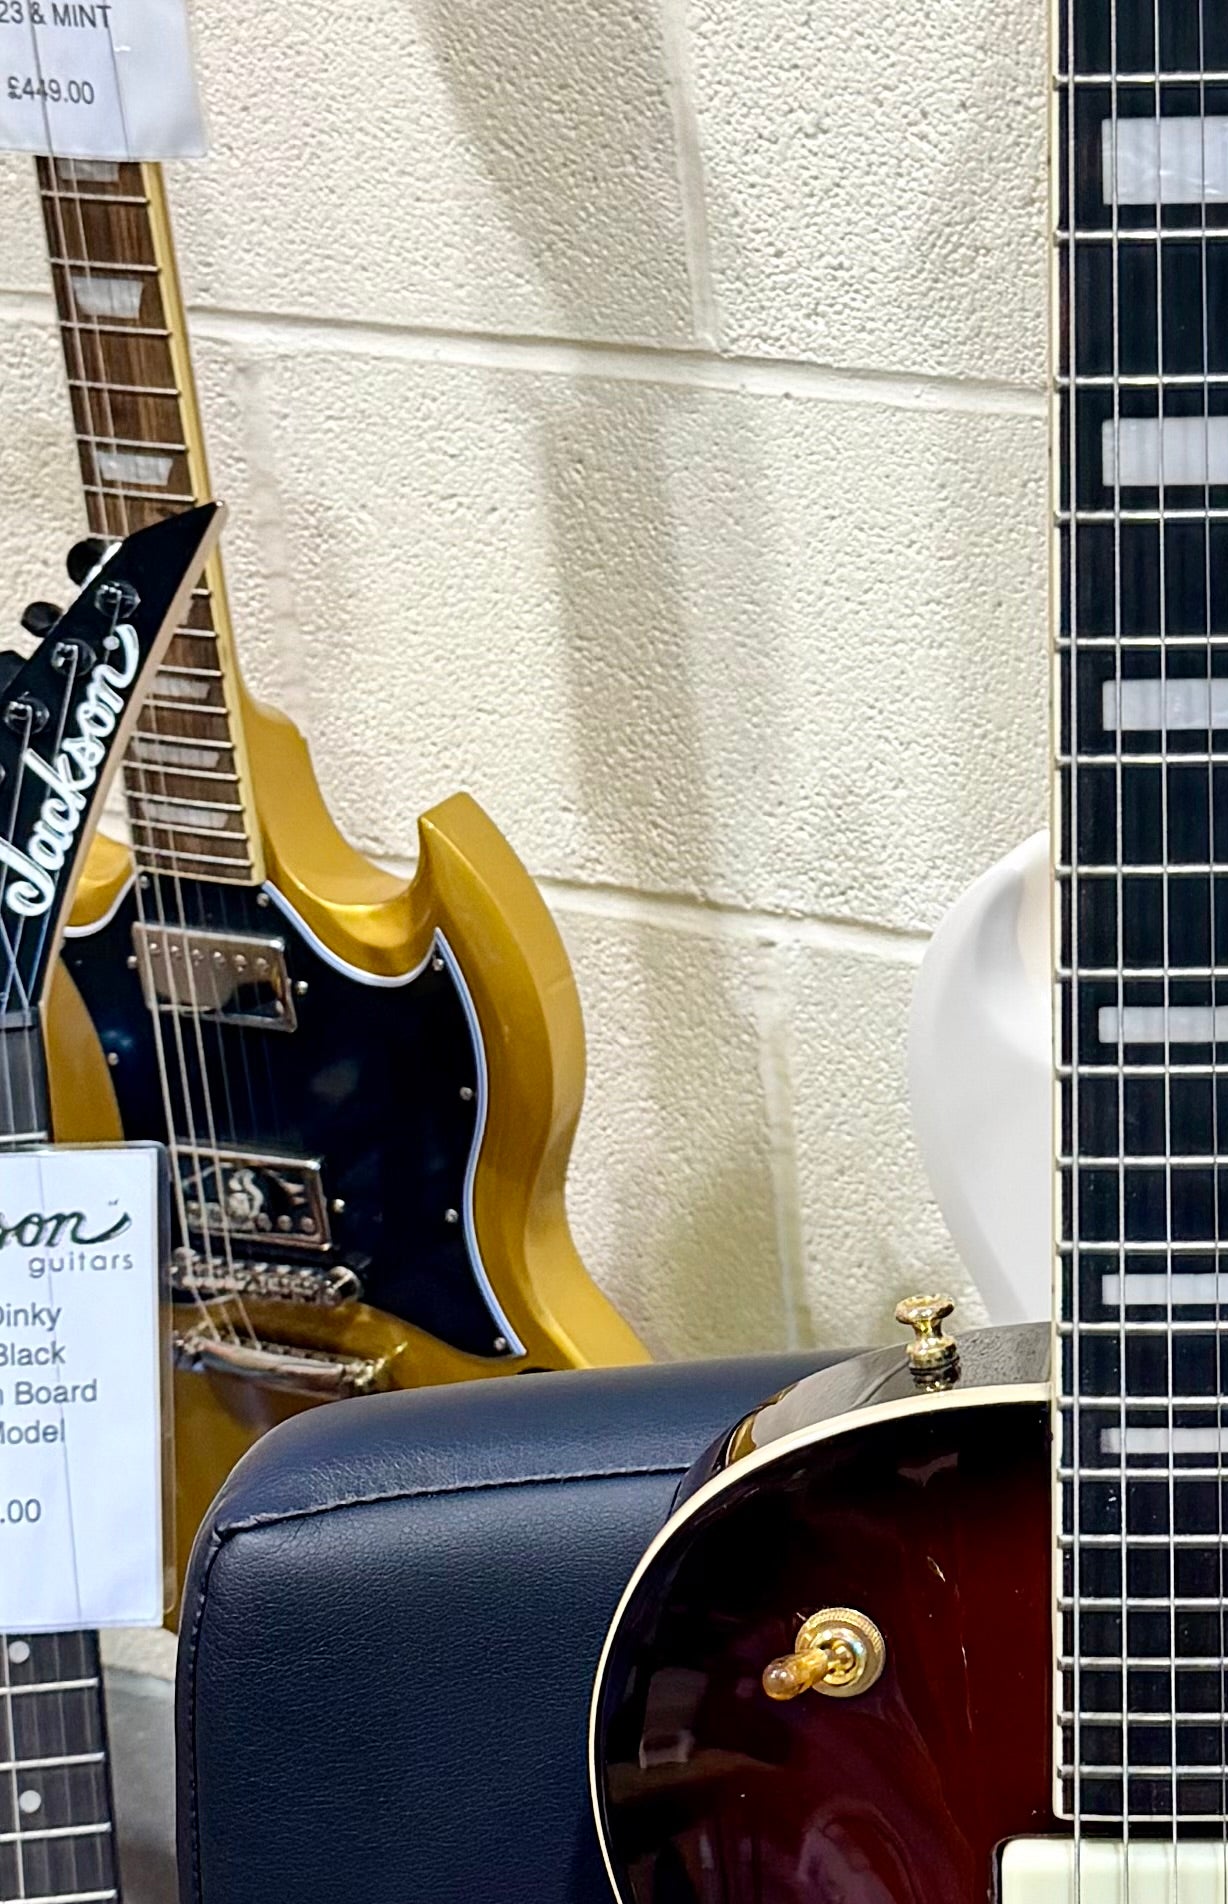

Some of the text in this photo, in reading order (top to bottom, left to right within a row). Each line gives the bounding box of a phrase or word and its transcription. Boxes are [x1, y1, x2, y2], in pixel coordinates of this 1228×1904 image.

[31, 1, 46, 25] &
[52, 3, 112, 28] MINT
[8, 76, 95, 104] £449.00
[0, 624, 139, 917] Jackson
[28, 1251, 133, 1279] guitars
[15, 1378, 98, 1406] Board
[0, 1418, 65, 1445] odel
